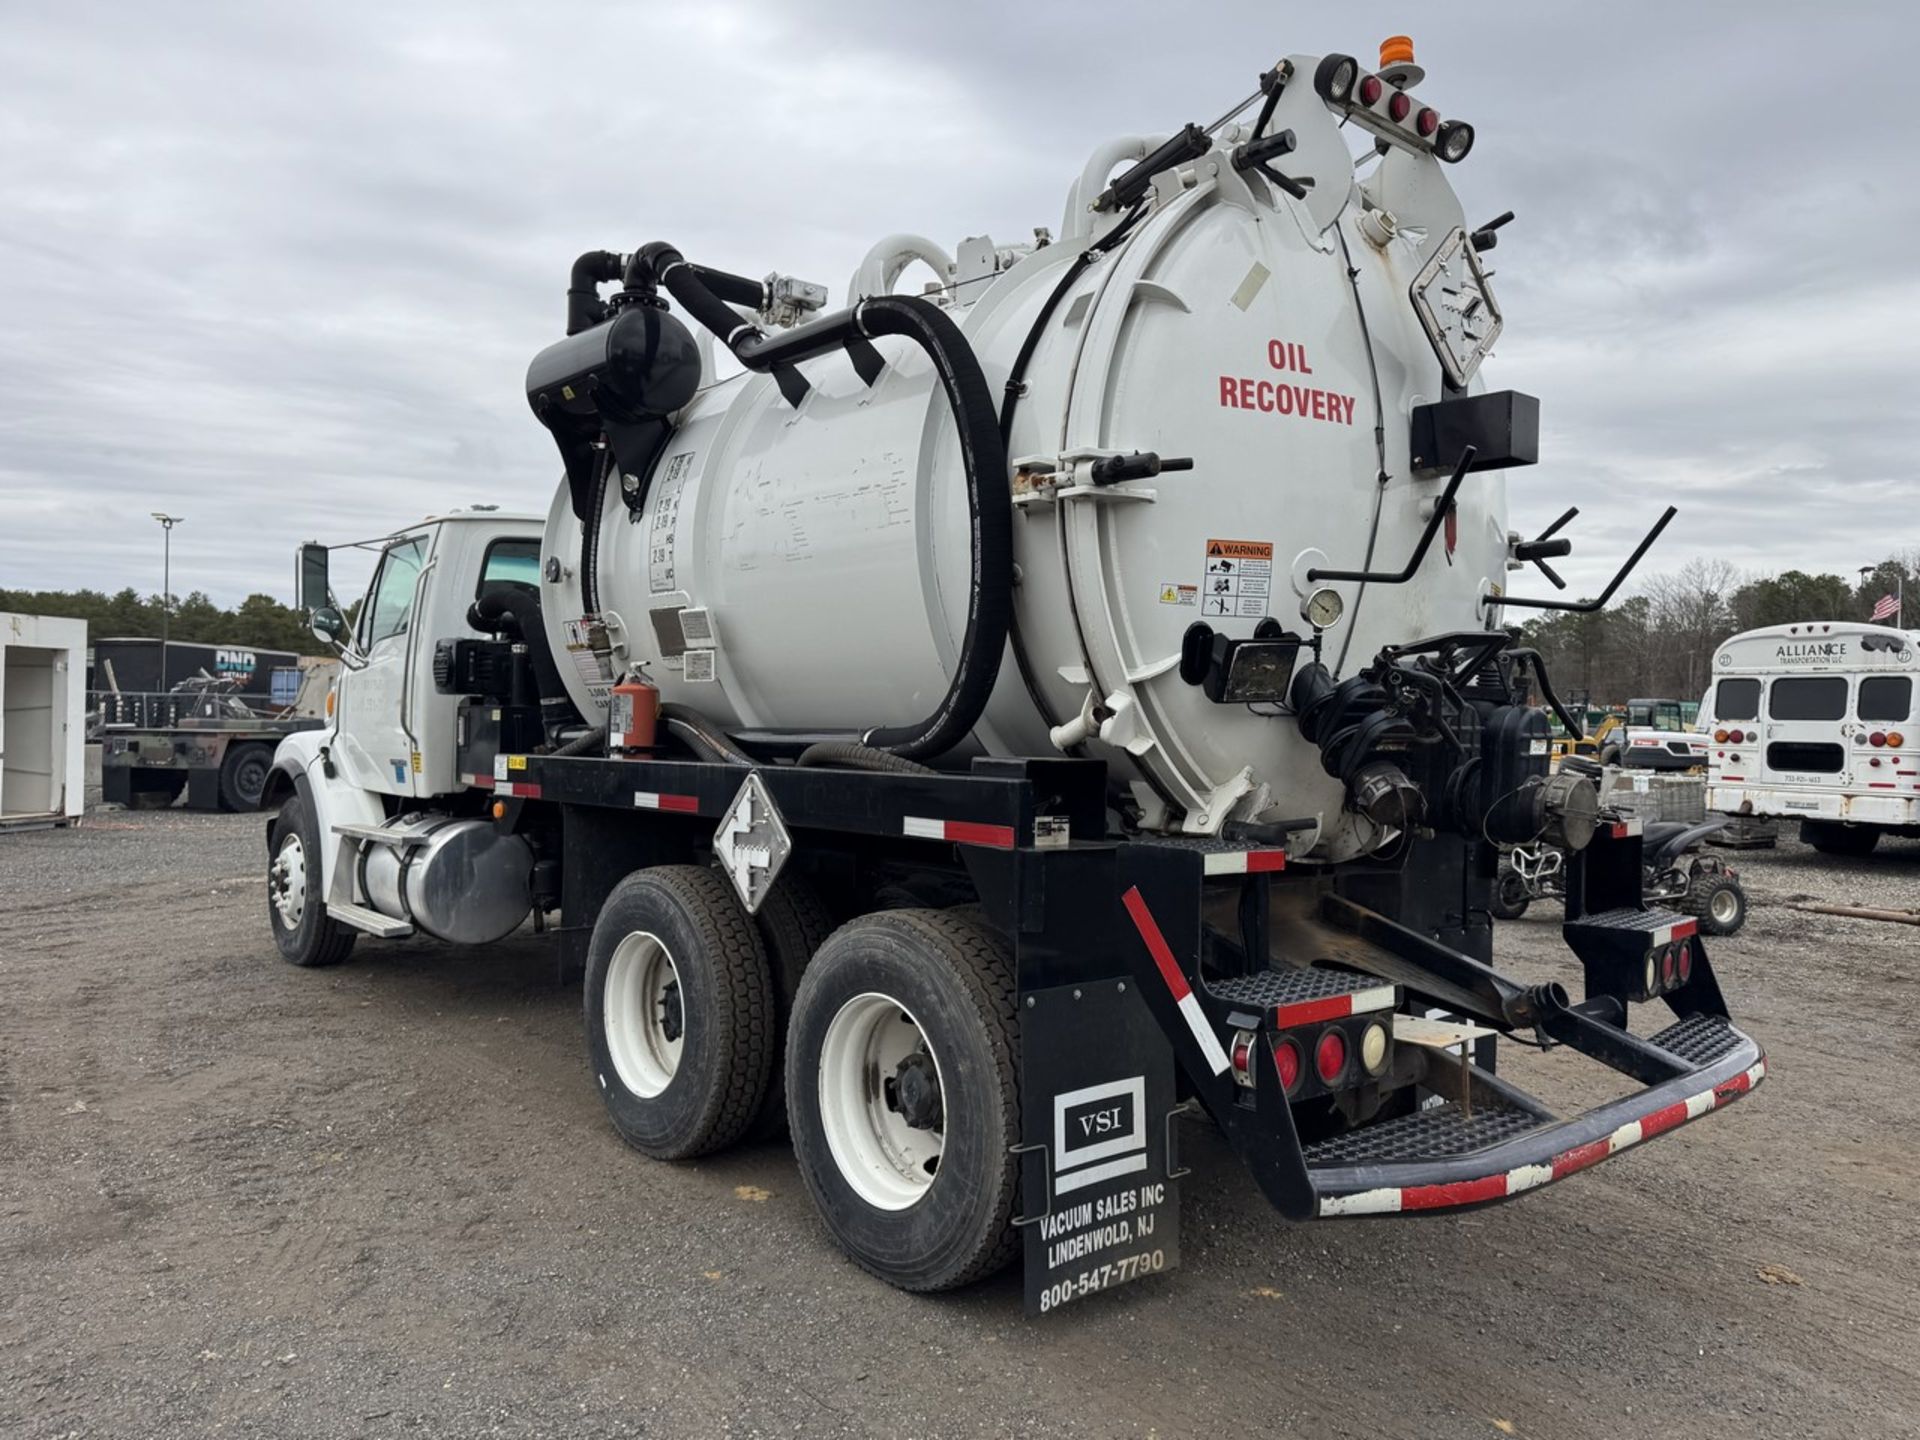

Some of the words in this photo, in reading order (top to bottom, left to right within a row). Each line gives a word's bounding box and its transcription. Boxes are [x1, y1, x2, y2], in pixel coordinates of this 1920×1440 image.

[1268, 339, 1312, 374] OIL
[1220, 376, 1355, 425] RECOVERY
[1223, 545, 1271, 557] WARNING
[216, 650, 256, 671] DND
[1776, 643, 1847, 657] ALLIANCE
[1079, 1107, 1122, 1137] VSI
[1040, 1202, 1092, 1242] VACUUM
[1096, 1189, 1137, 1220] SALES
[1141, 1183, 1165, 1209] INC
[1048, 1221, 1133, 1270] LINDENWOLD,
[1137, 1213, 1155, 1239] NJ
[1040, 1249, 1164, 1313] 800-547-7790
